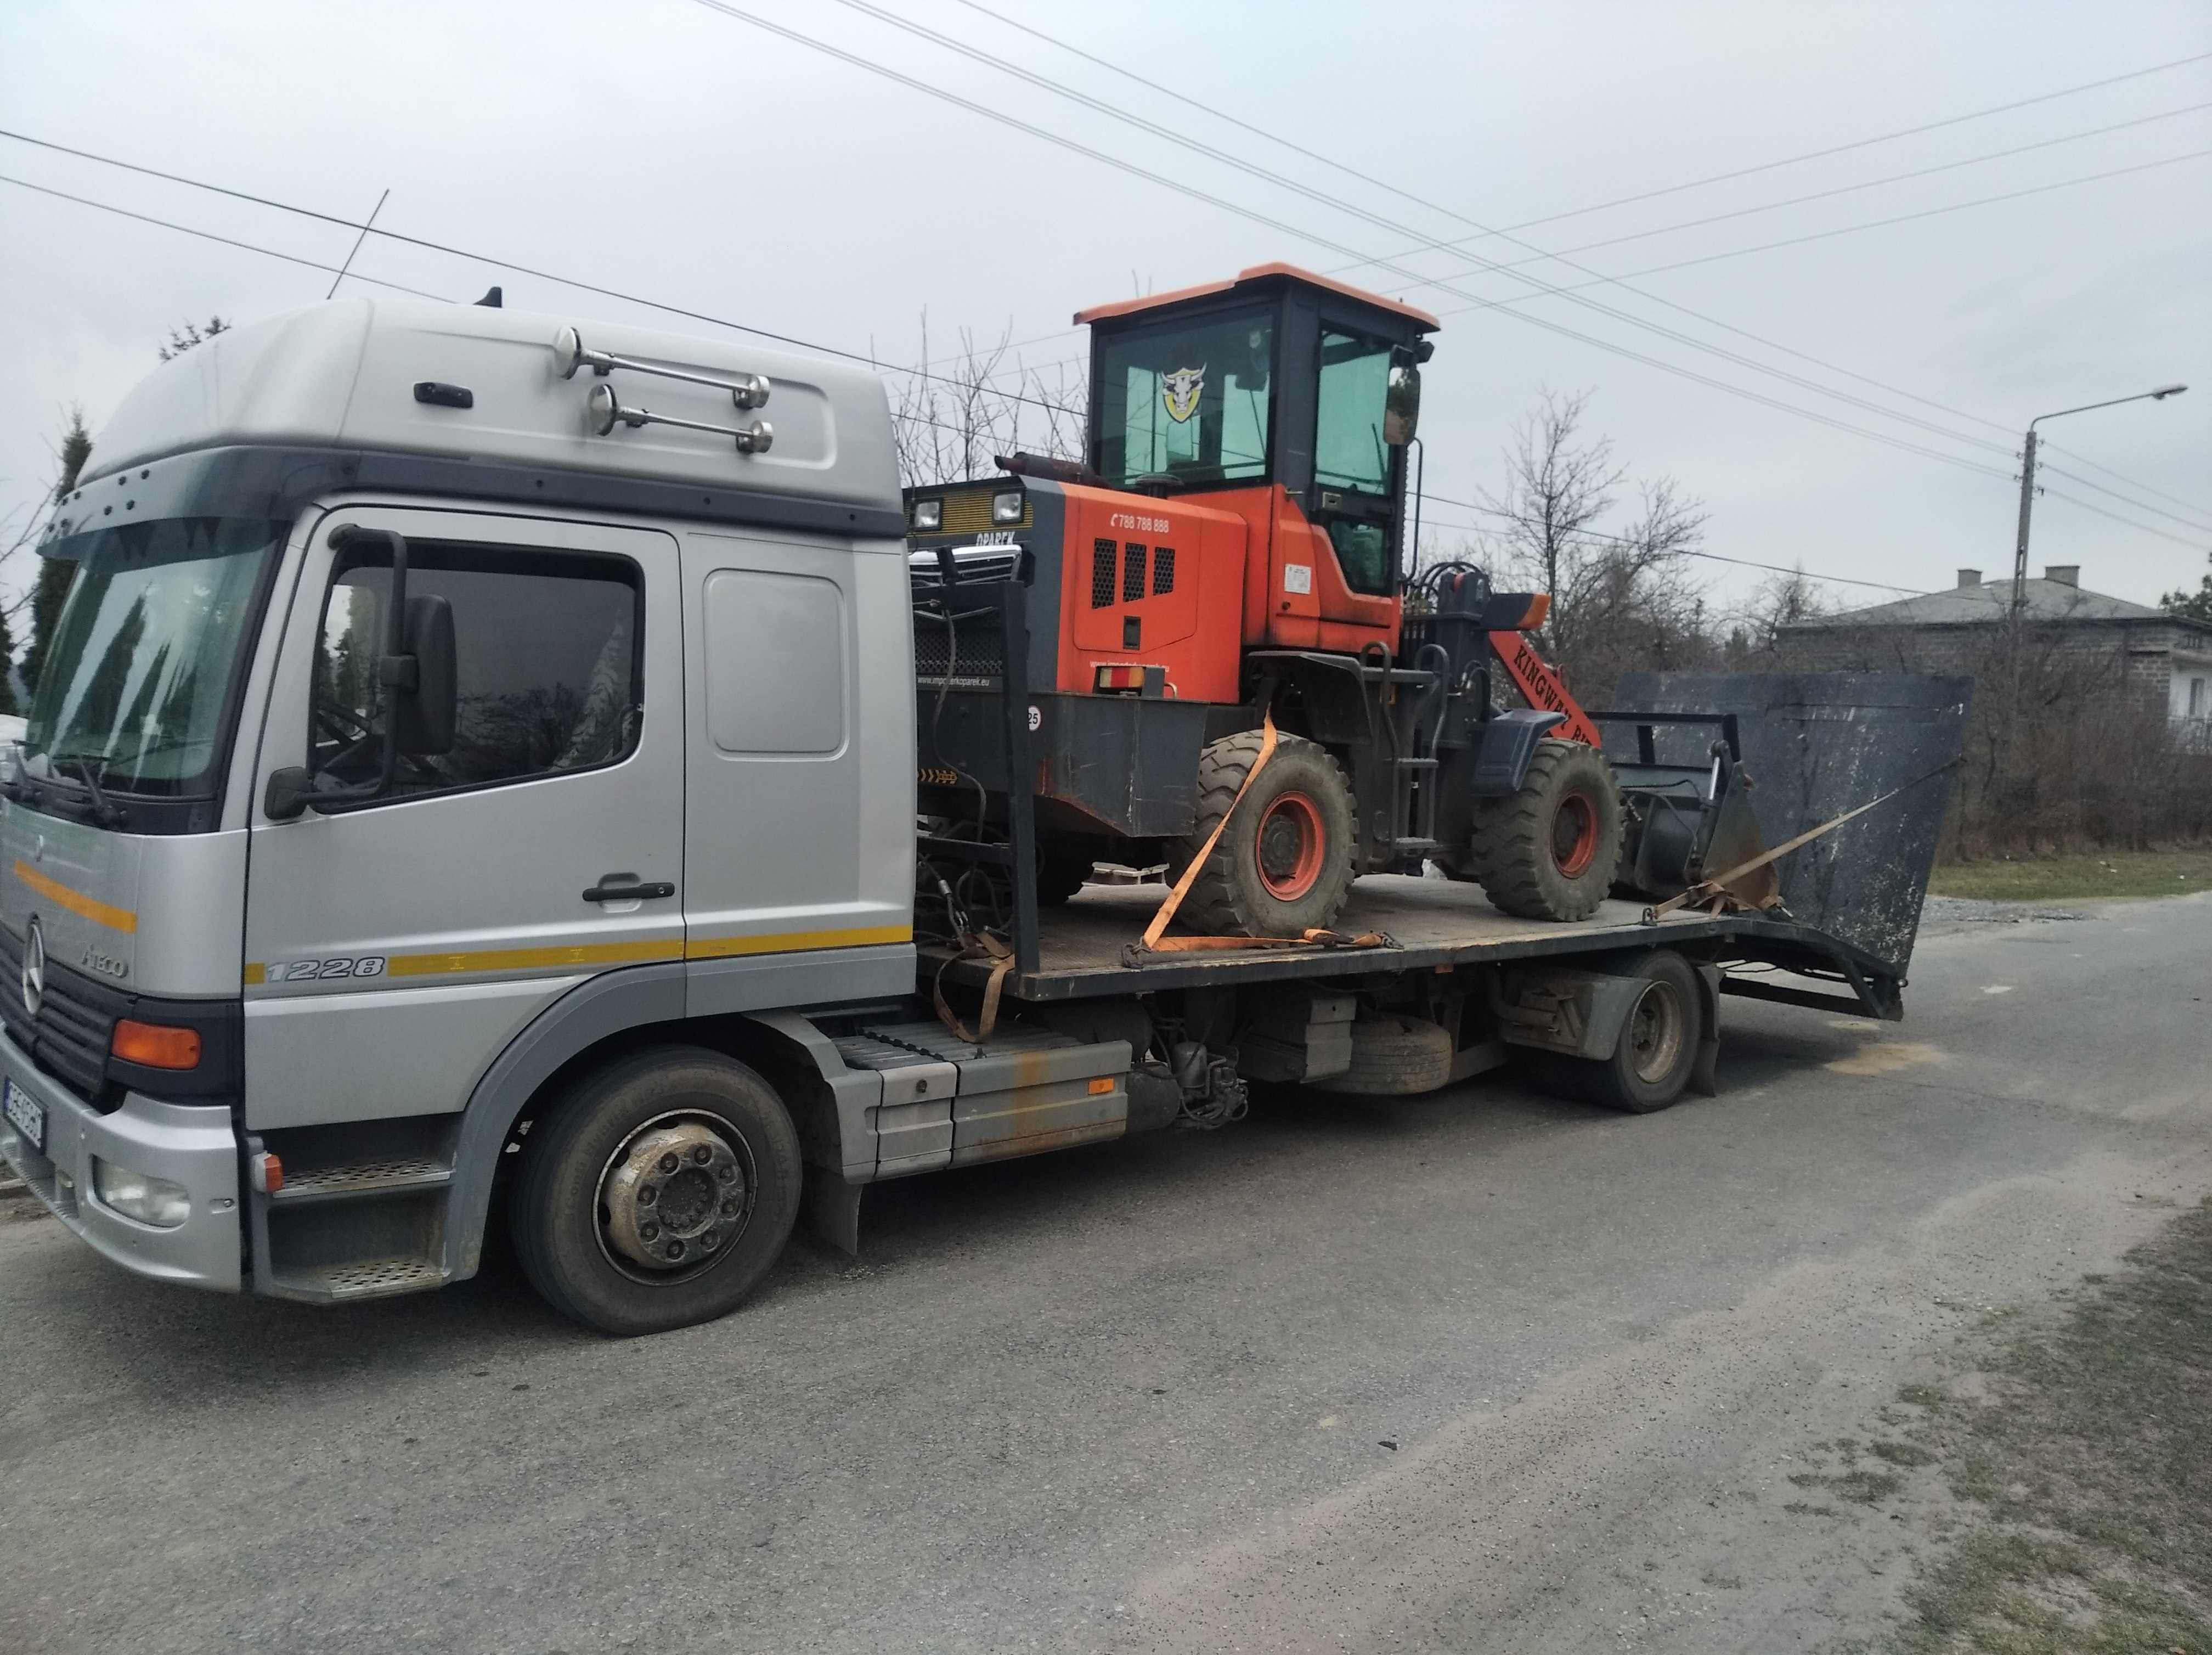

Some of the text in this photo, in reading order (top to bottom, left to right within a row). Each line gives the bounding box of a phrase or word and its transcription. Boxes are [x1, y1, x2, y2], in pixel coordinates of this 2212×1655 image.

[1119, 514, 1169, 533] 788 788 888
[1028, 713, 1038, 724] 25
[267, 956, 385, 983] 1228
